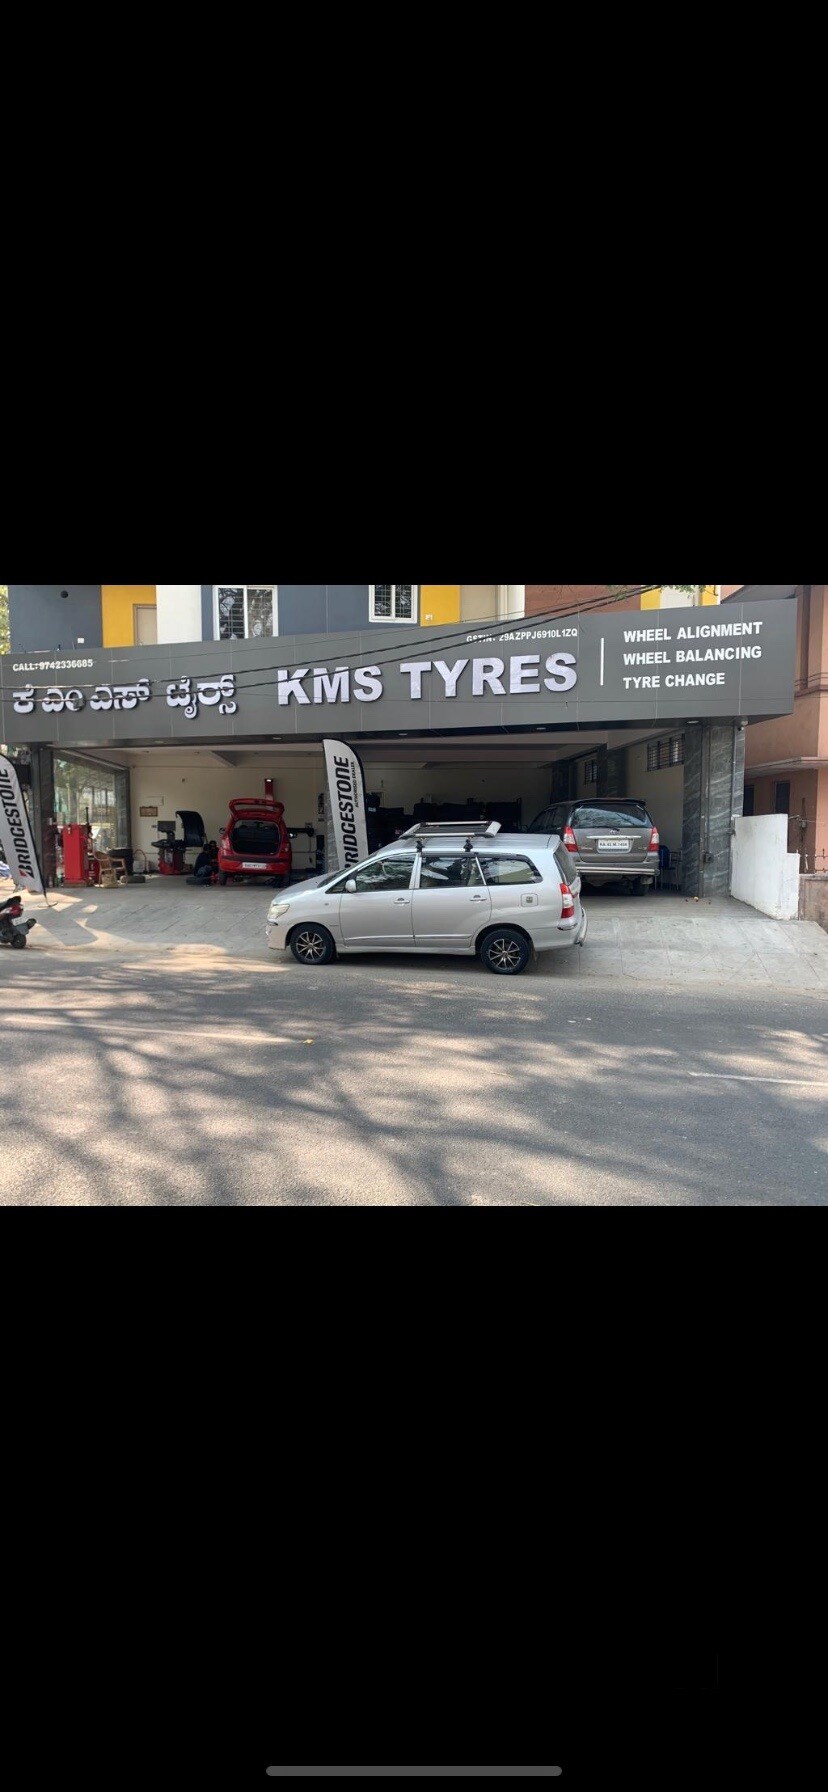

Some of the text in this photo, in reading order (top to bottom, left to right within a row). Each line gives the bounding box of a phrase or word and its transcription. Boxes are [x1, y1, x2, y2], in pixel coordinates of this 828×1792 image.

[623, 621, 763, 643] WHEEL ALIGNMENT
[623, 645, 762, 666] WHEEL BALANCING
[277, 652, 578, 705] KMS TYRES
[623, 672, 726, 689] TYRE CHANGE
[333, 755, 359, 869] RIDGESTONE
